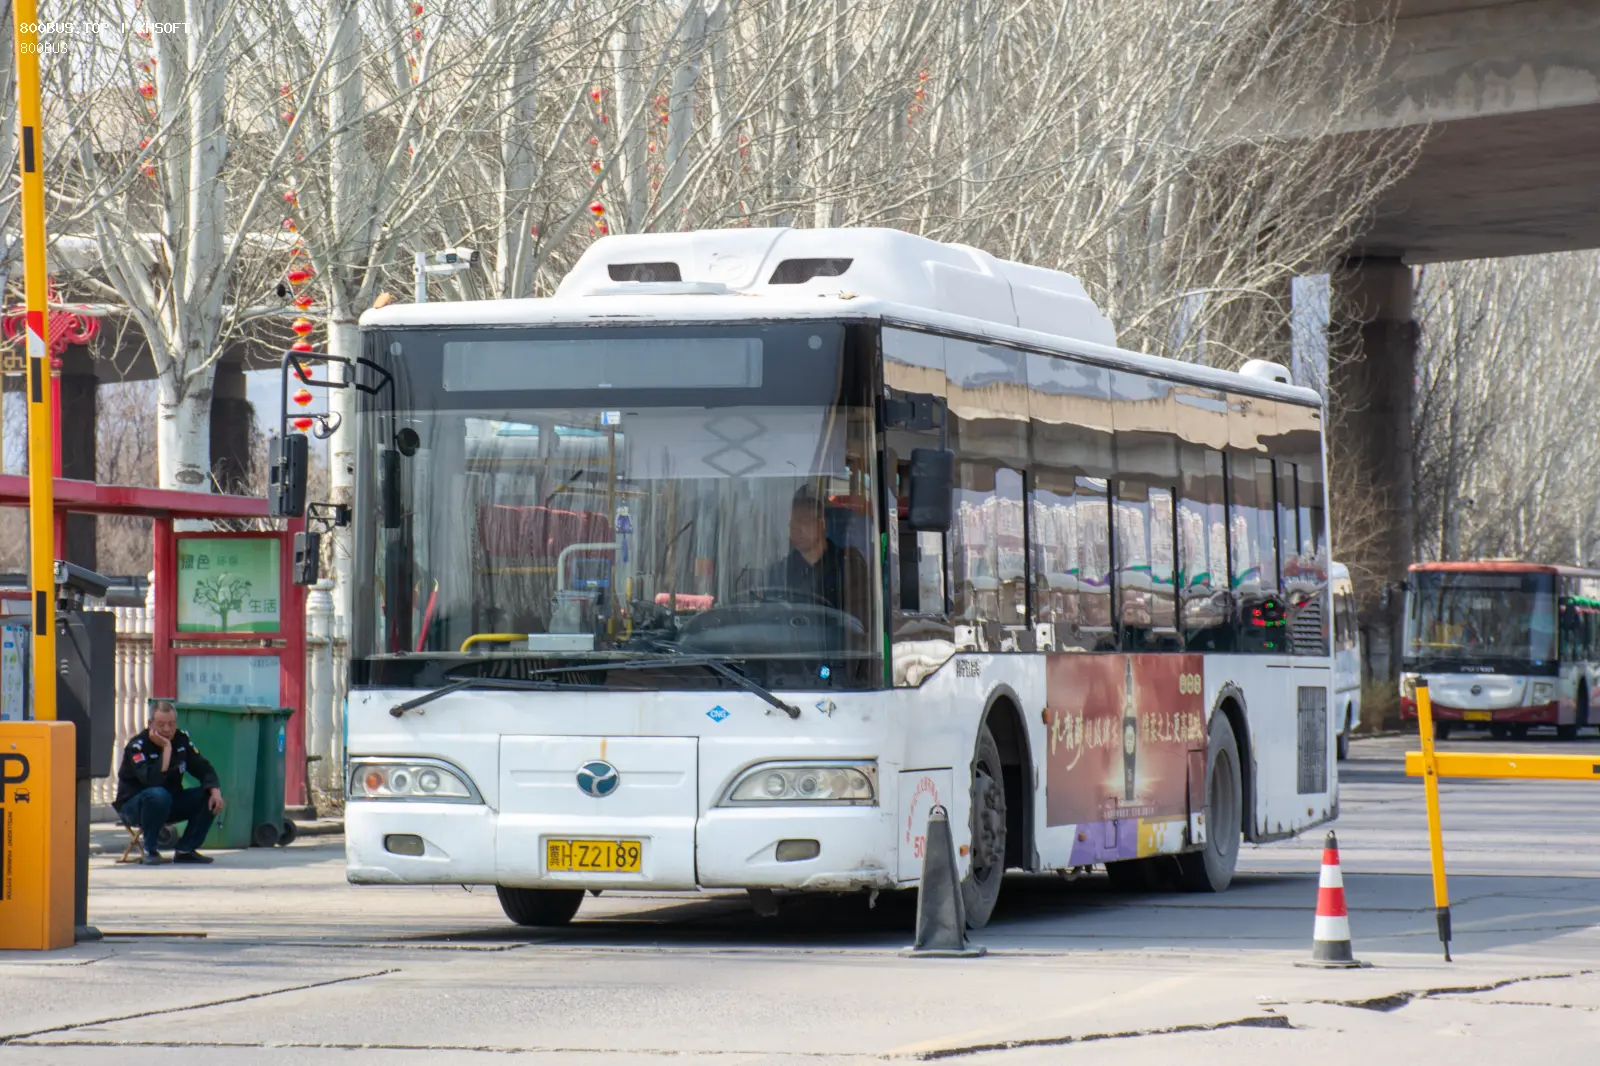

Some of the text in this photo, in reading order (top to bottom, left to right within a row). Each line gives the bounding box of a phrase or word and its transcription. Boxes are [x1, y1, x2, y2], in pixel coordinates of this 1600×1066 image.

[248, 599, 277, 613] 生活
[710, 710, 727, 718] CNG
[0, 753, 30, 803] P
